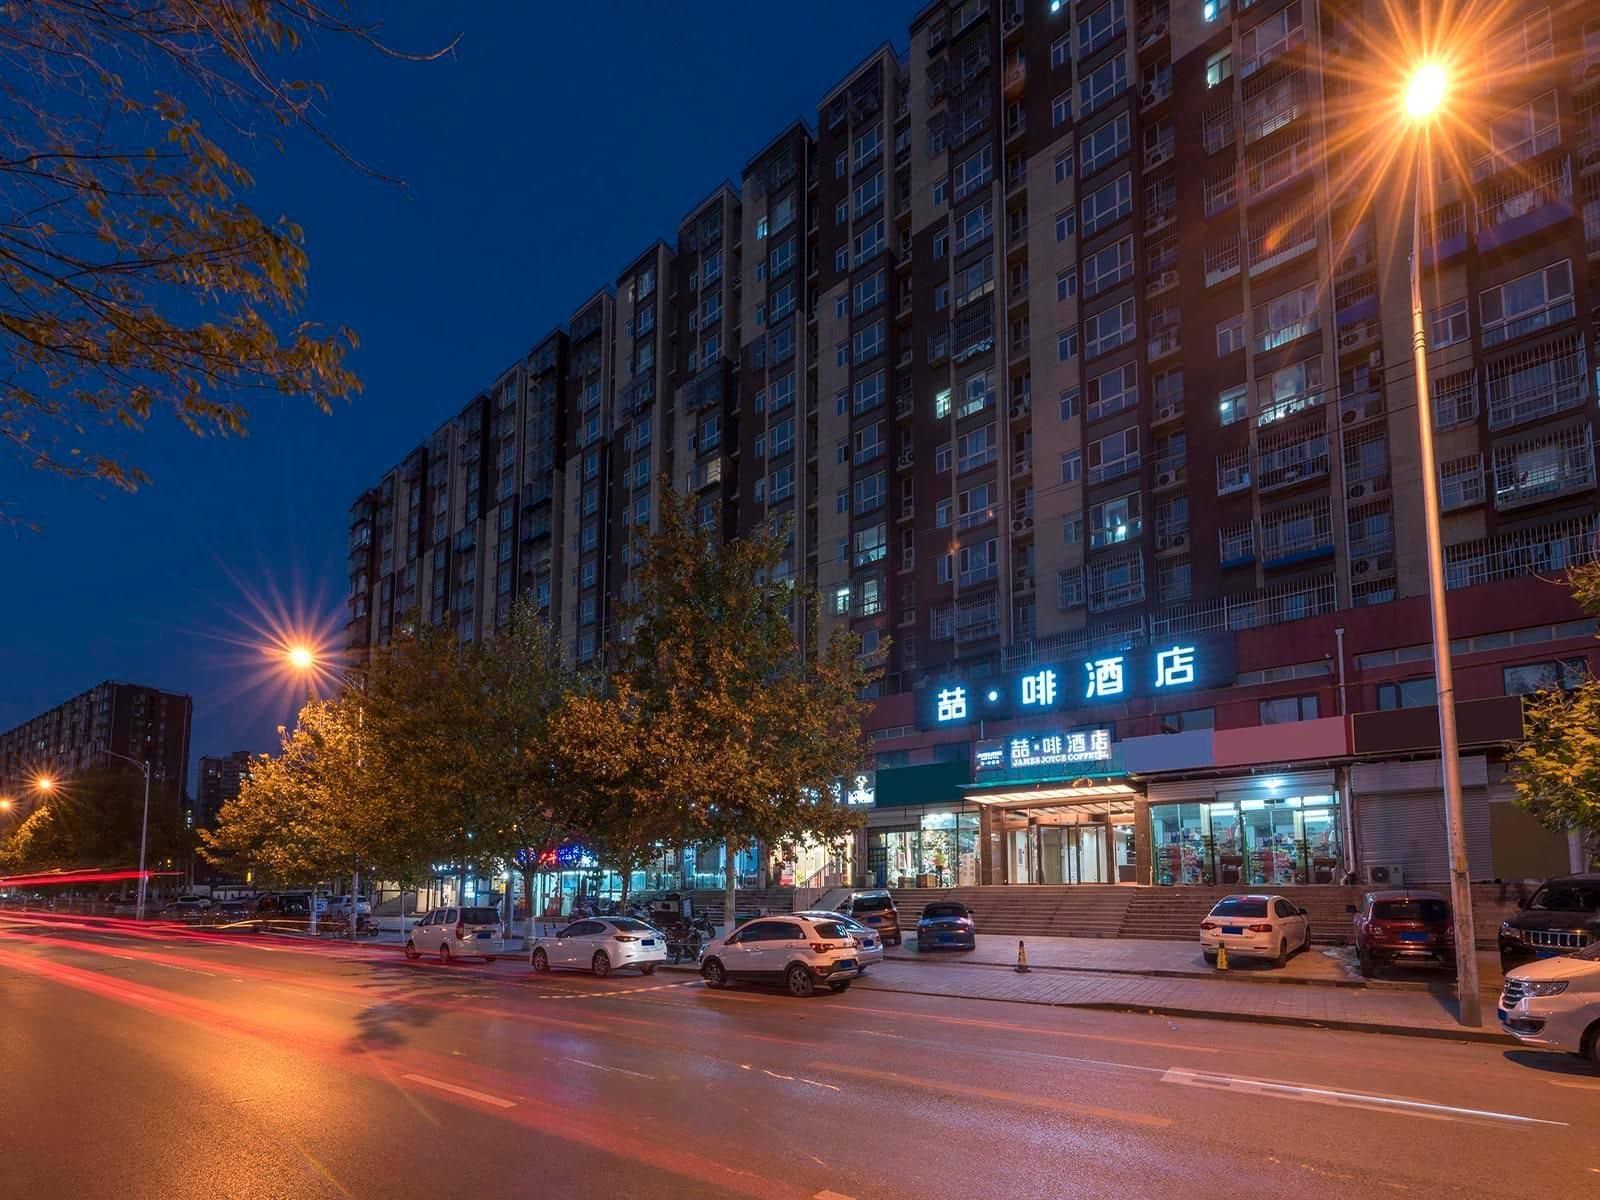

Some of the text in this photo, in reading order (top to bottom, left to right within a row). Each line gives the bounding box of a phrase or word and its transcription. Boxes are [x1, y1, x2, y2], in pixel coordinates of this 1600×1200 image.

[938, 646, 1196, 721] 喆·啡酒店
[1041, 754, 1067, 764] JOYCE
